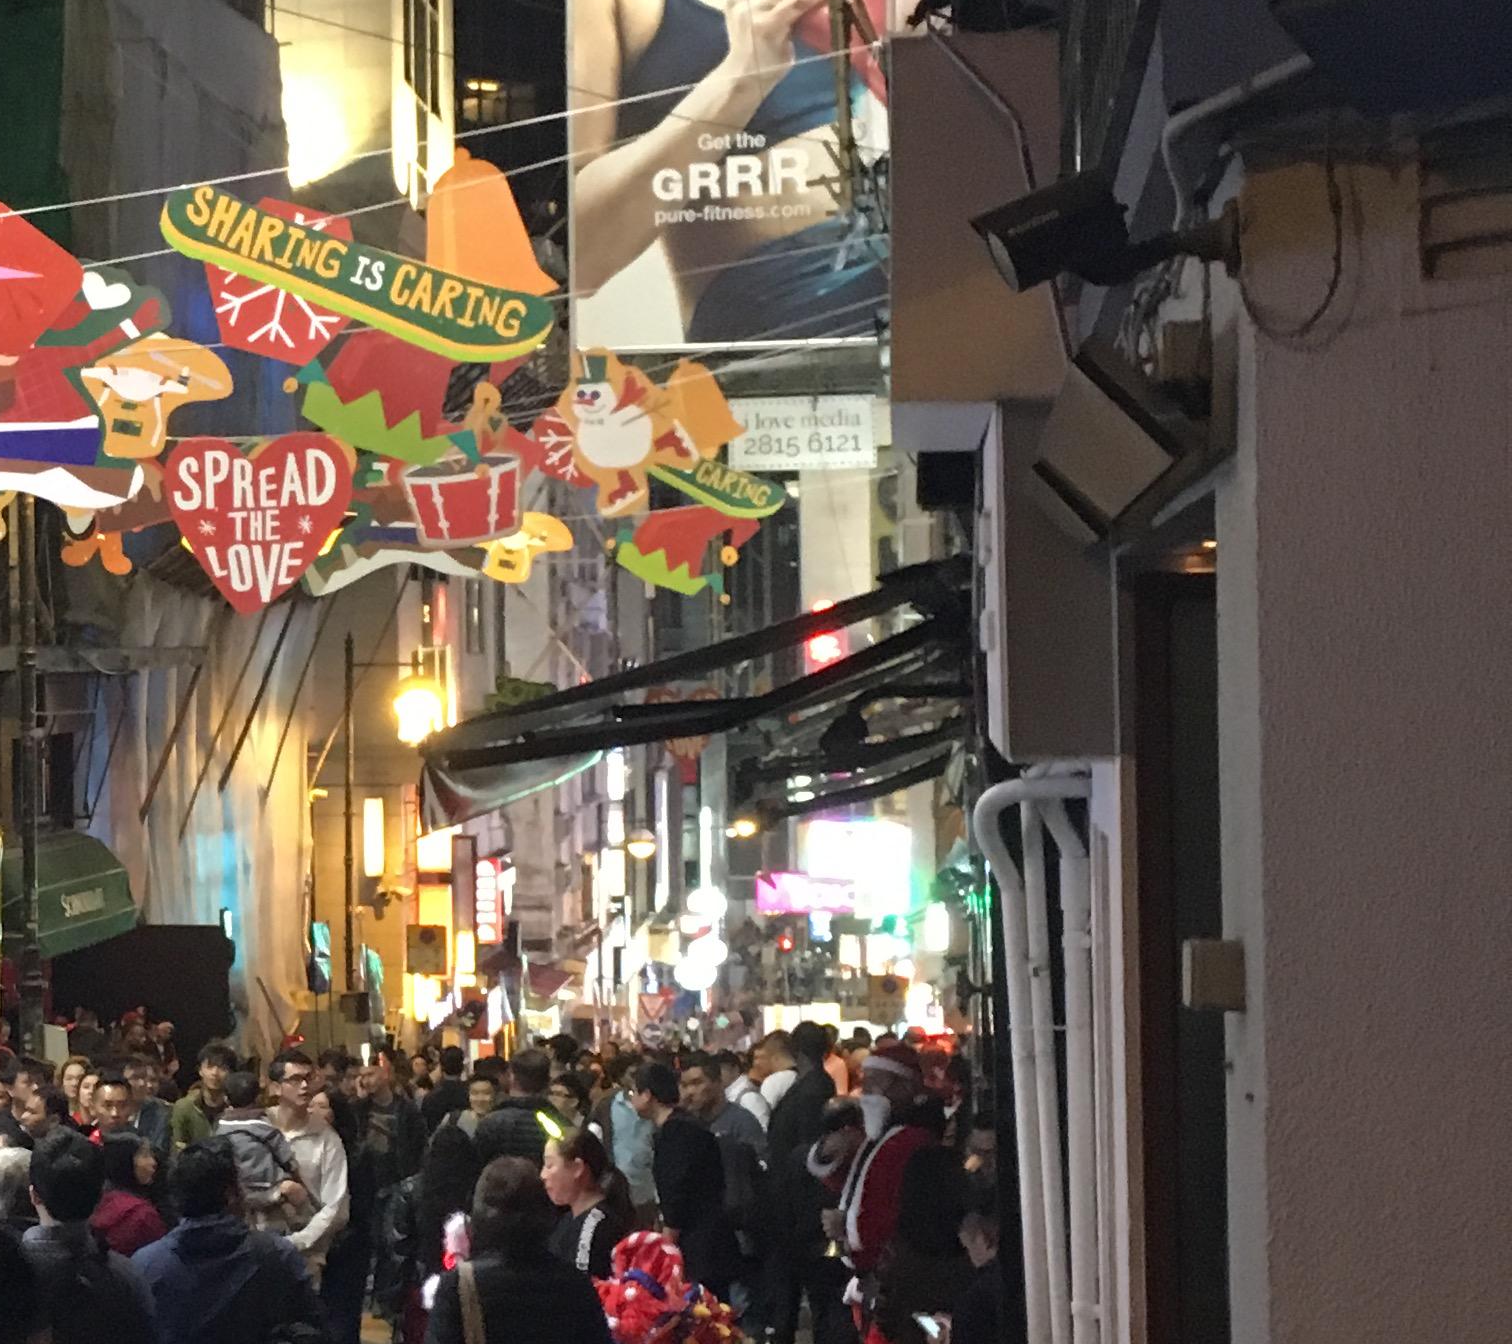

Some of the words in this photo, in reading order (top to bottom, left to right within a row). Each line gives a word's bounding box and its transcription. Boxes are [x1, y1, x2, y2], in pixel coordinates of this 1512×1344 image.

[698, 132, 731, 152] Get
[736, 130, 766, 149] the
[651, 147, 812, 202] GRRR
[654, 203, 811, 227] pure-fitness.com
[186, 186, 346, 279] SHARING
[349, 255, 384, 293] IS
[389, 262, 528, 338] CARING
[755, 412, 794, 430] love
[800, 408, 861, 428] media
[743, 433, 800, 458] 2815
[808, 432, 861, 454] 6121
[173, 449, 337, 511] SPREAD
[696, 460, 772, 507] CARING
[228, 511, 281, 542] THE
[206, 541, 303, 604] LOVE
